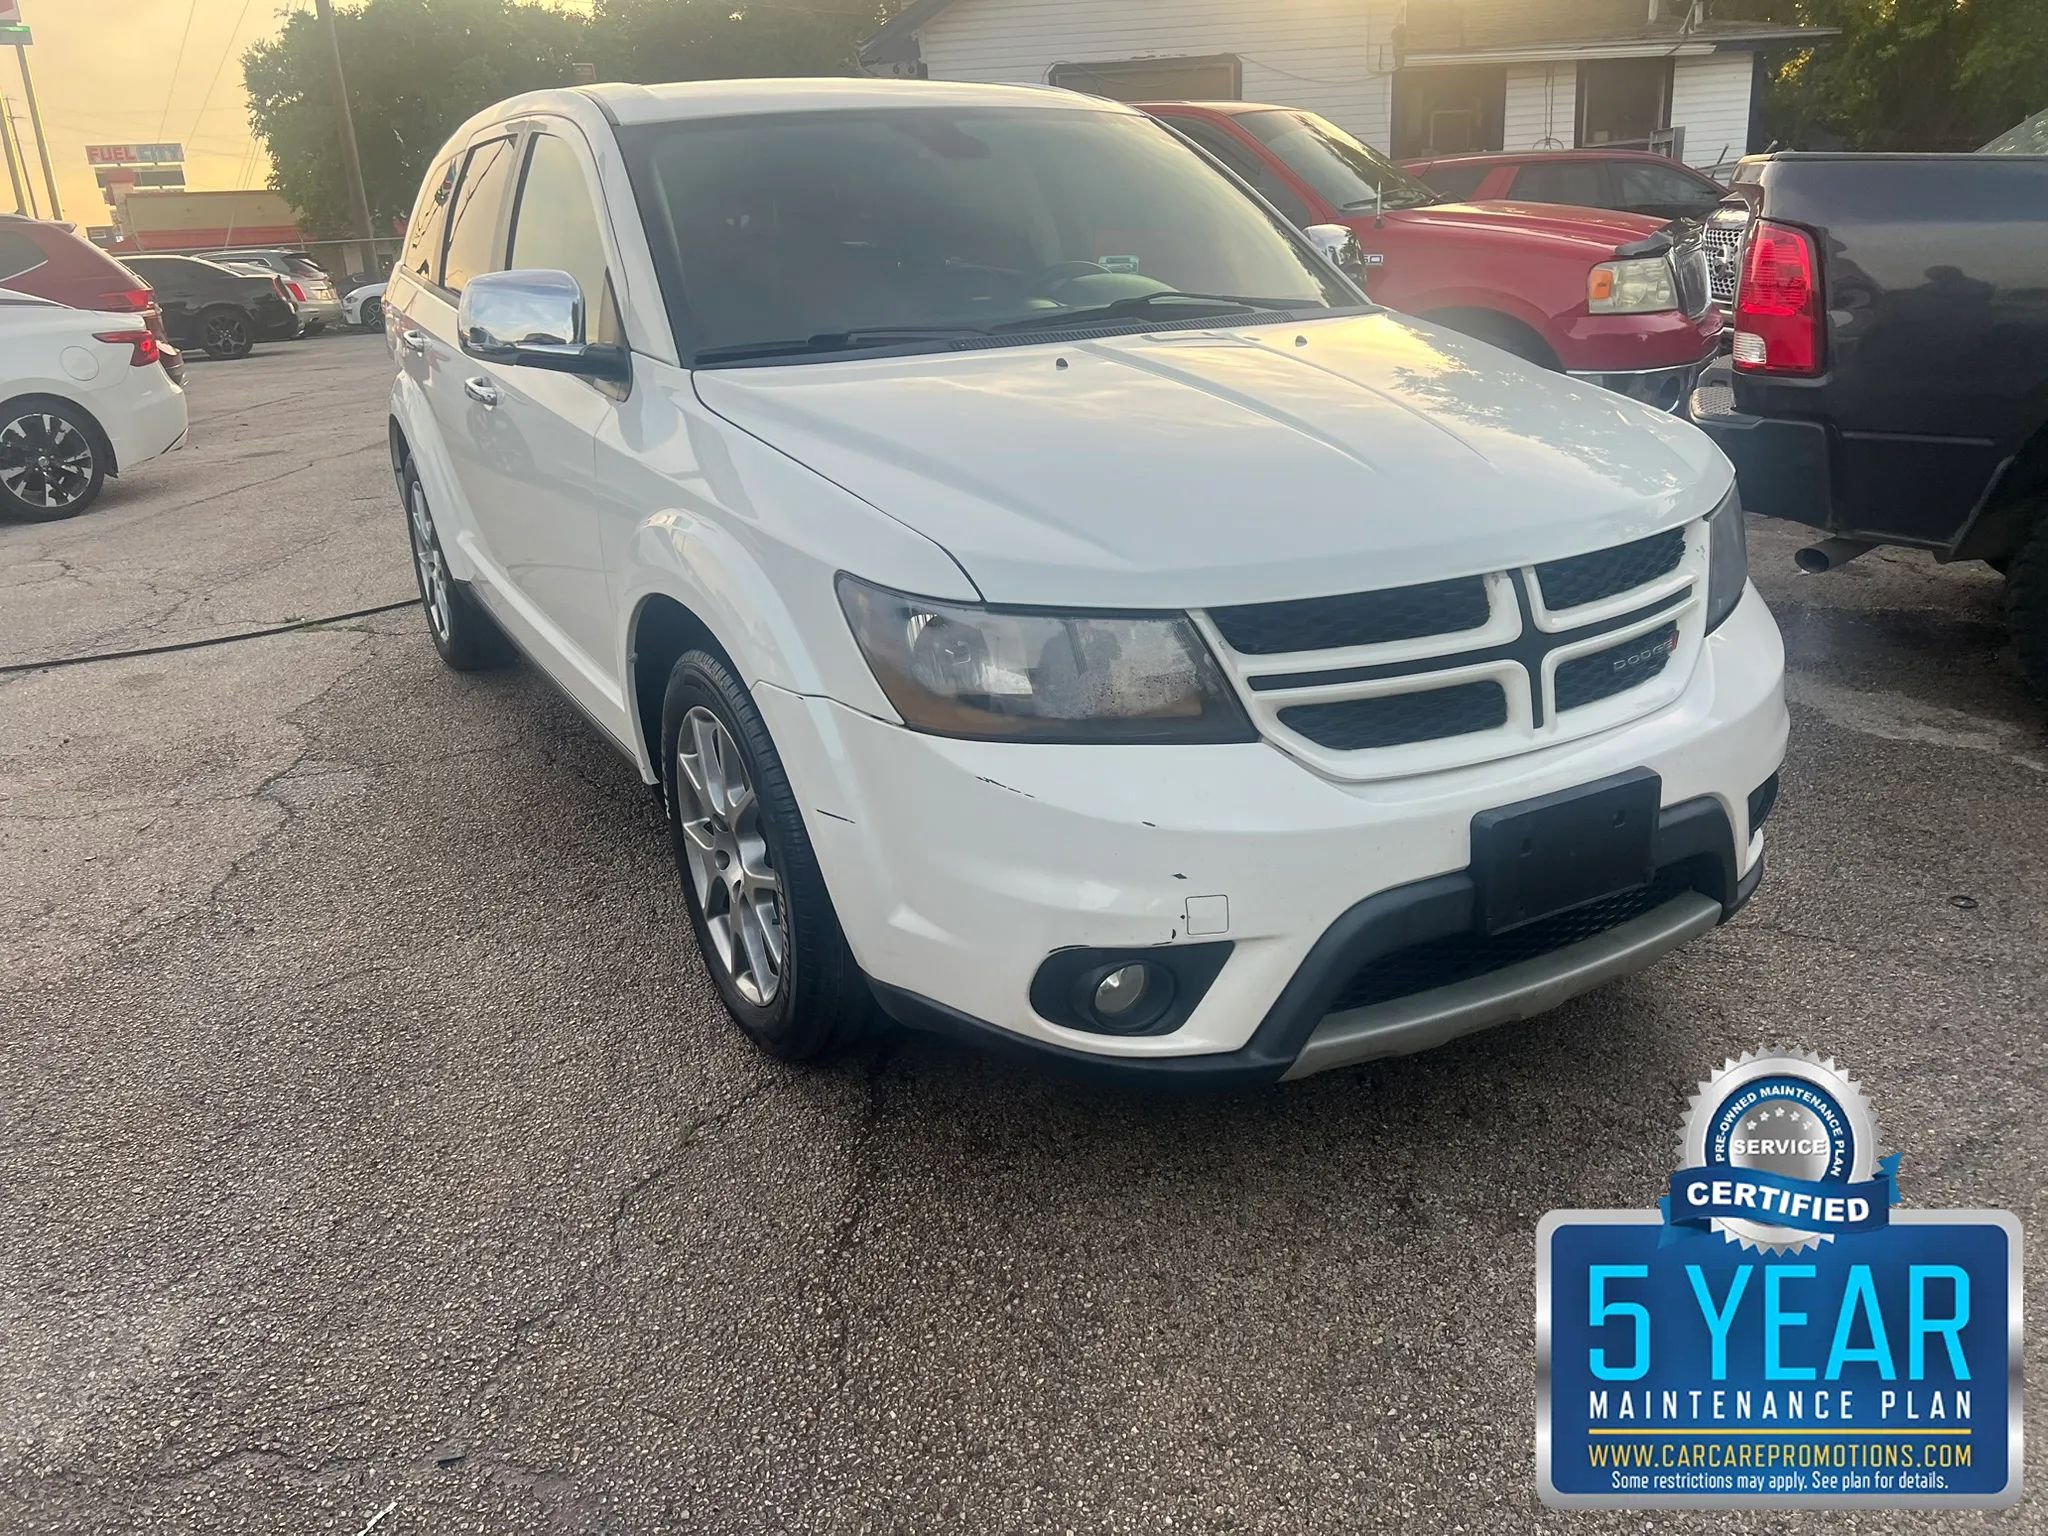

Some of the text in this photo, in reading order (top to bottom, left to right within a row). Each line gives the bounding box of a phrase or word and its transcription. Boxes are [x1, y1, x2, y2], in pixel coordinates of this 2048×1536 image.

[89, 145, 181, 161] FUEL CITY
[1613, 638, 1673, 671] DODGE
